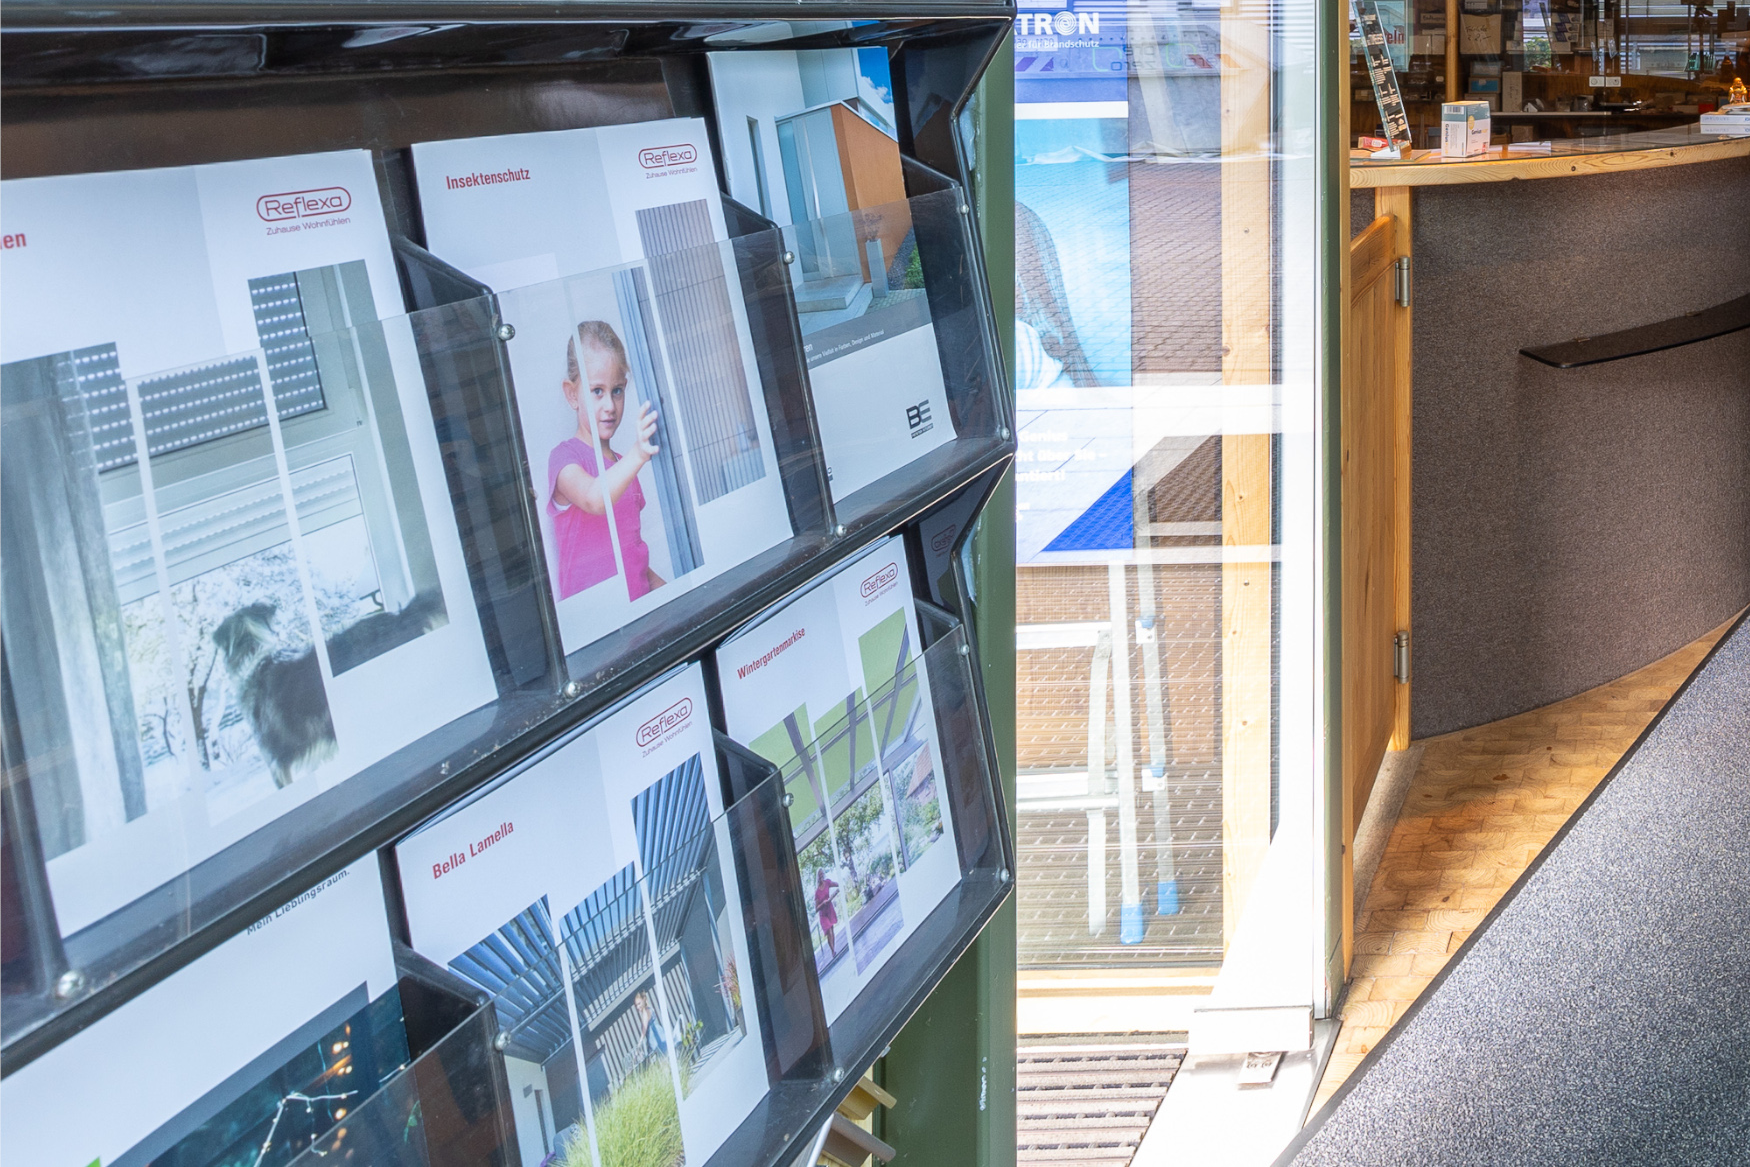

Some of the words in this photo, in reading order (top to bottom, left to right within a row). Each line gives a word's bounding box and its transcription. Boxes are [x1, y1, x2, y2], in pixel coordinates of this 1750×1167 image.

[1028, 40, 1042, 50] für
[1044, 39, 1100, 50] Brandschutz
[644, 149, 692, 168] Reflexa
[446, 167, 531, 191] Insektenschutz
[646, 170, 668, 180] Zuhause
[668, 165, 698, 177] Wohnfühlen
[265, 194, 343, 219] Reflexa
[266, 223, 301, 236] Zuhause
[302, 216, 352, 232] Wohnfühlen
[906, 399, 933, 430] BE
[863, 567, 896, 594] Reflexa
[736, 626, 807, 681] Wintergartenmarkise
[640, 703, 690, 744] Reflexa
[642, 739, 665, 759] Zuhause
[664, 719, 694, 744] Wohnfühlen
[432, 850, 466, 880] Bella
[468, 820, 515, 858] Lamella
[246, 912, 273, 936] Mein
[274, 868, 351, 919] Lieblingsraum.
